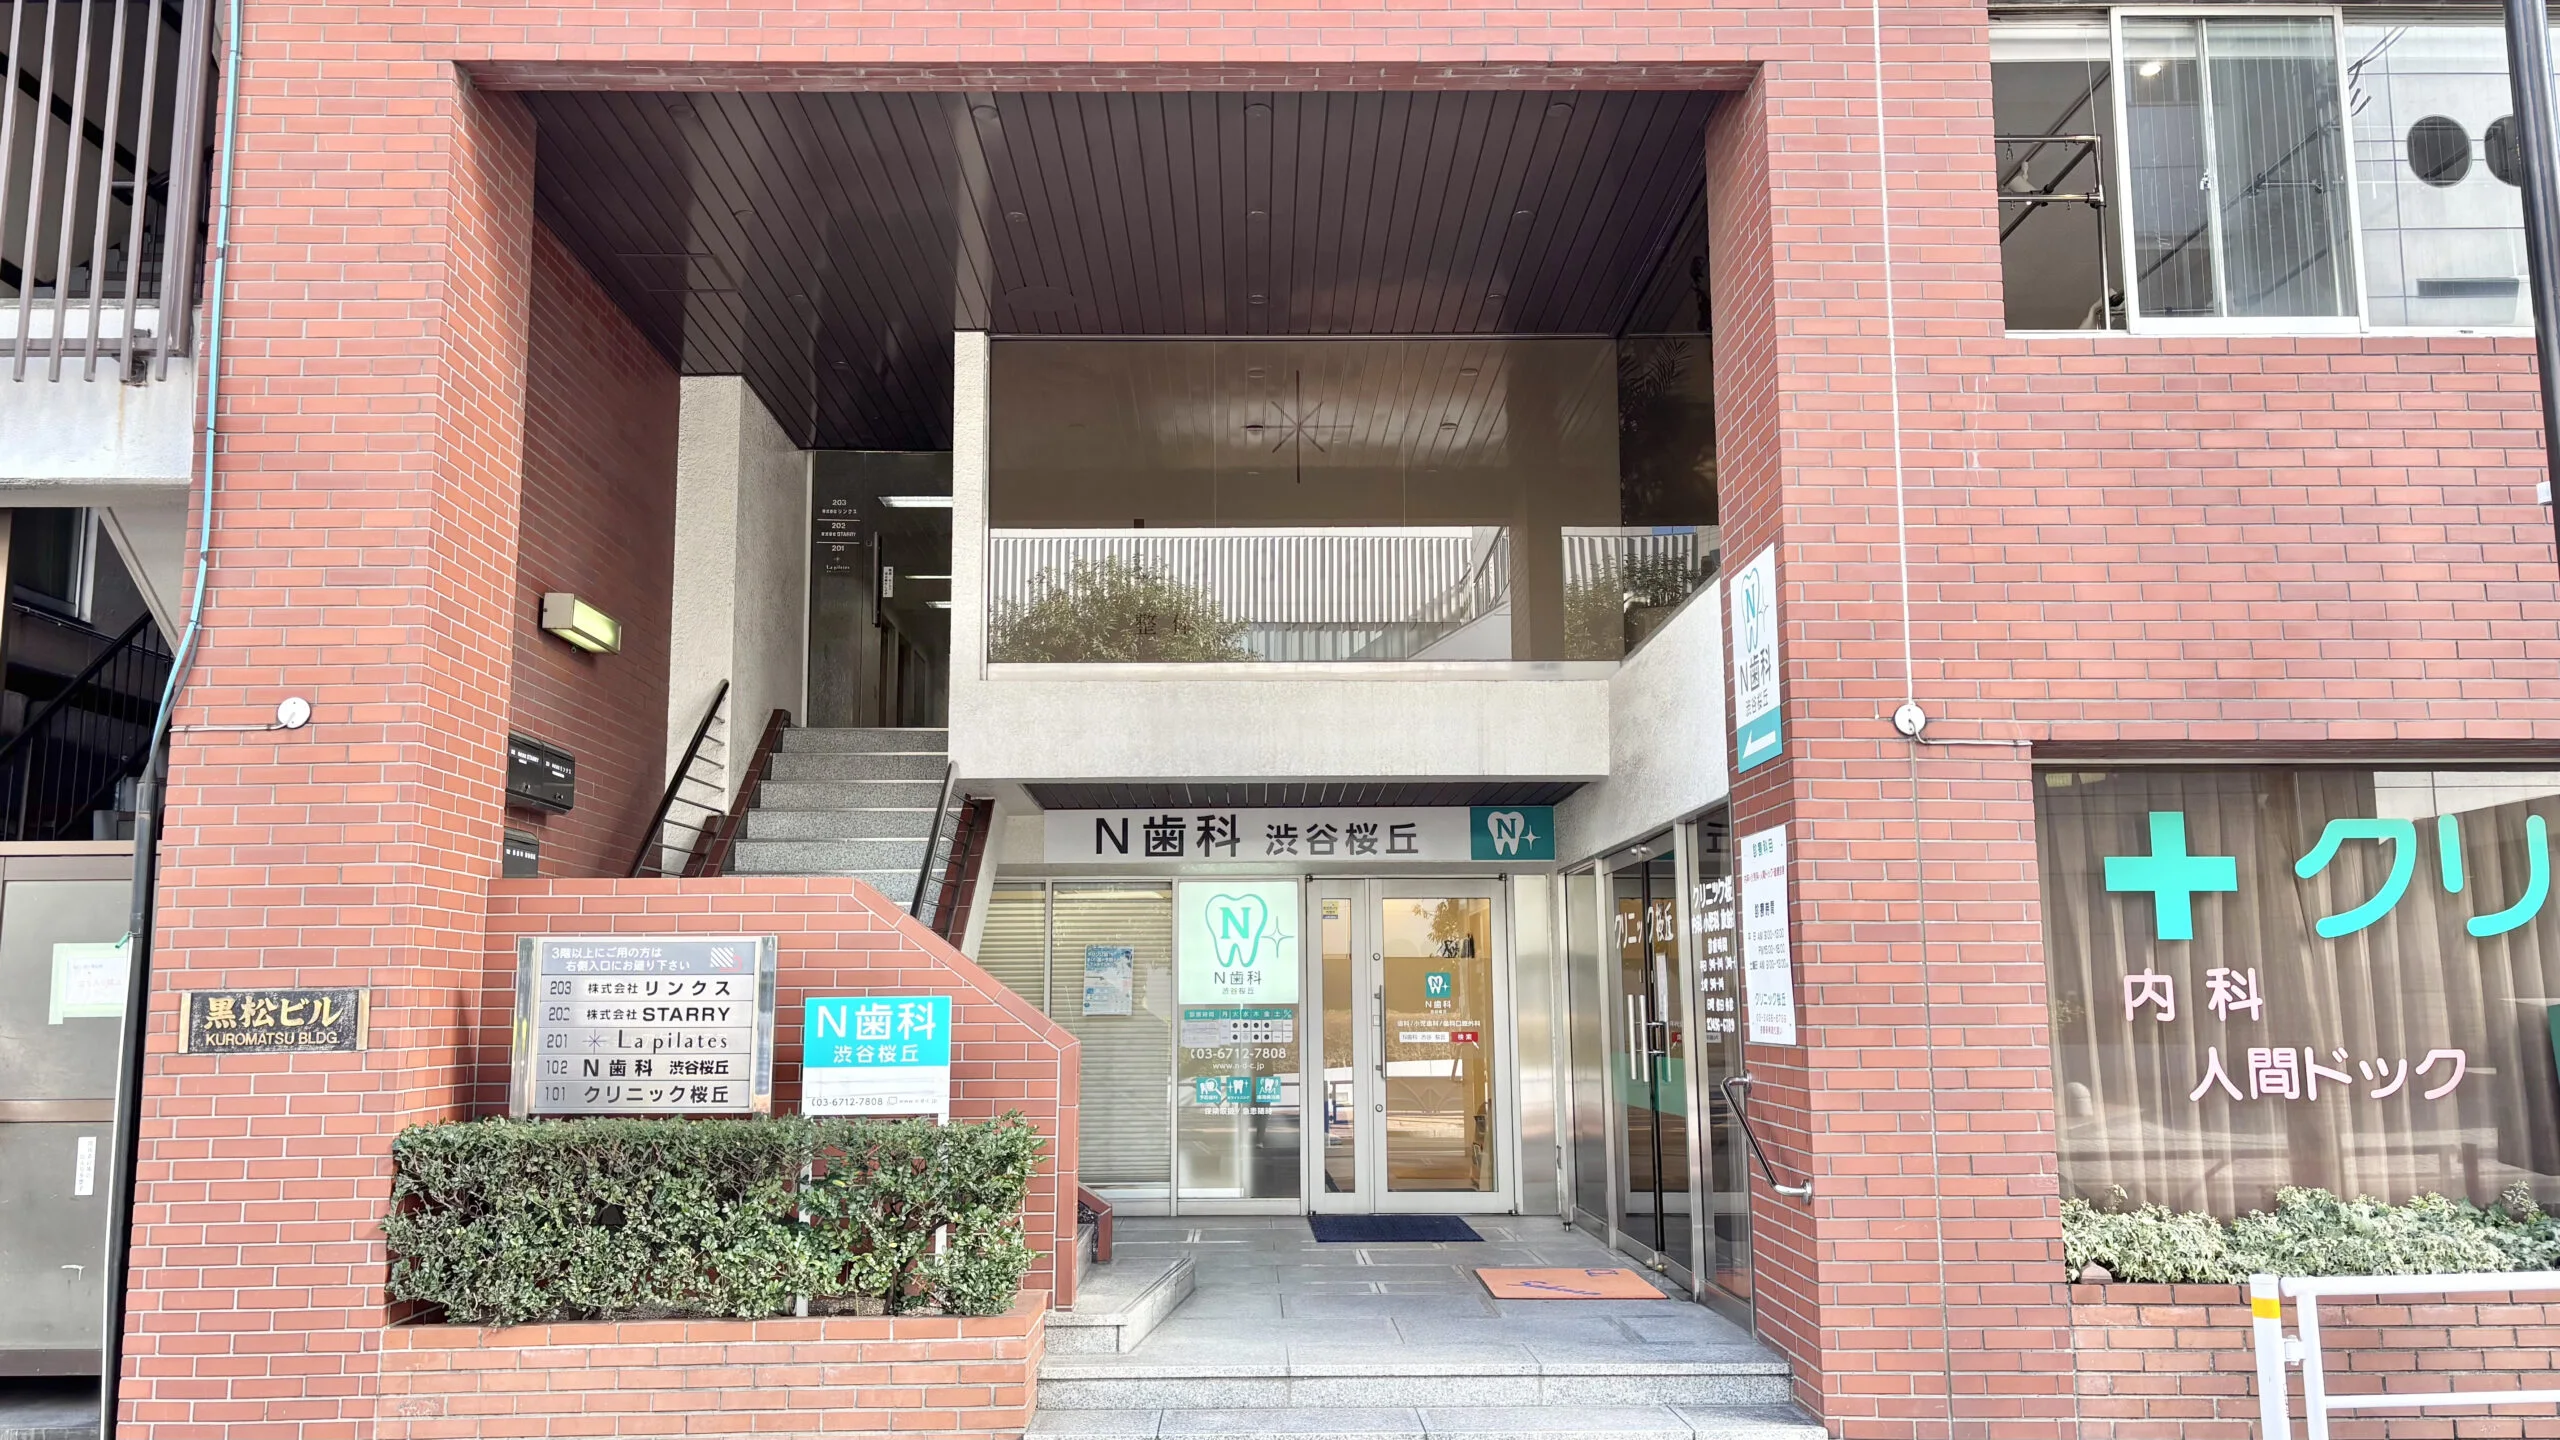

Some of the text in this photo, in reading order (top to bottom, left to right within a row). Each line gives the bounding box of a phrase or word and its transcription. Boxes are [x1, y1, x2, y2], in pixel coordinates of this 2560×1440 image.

[1740, 644, 1771, 696] N歯科
[1095, 814, 1420, 858] N歯科 渋谷桜丘
[2295, 814, 2550, 938] クリ
[551, 946, 662, 959] 3階以上にご用の方は
[1214, 970, 1262, 985] N歯科
[550, 981, 572, 995] 203
[2123, 967, 2263, 1022] 内科
[203, 995, 344, 1030] 黒松ビル
[642, 1007, 731, 1022] STARRY
[817, 1001, 936, 1040] N歯科
[205, 1031, 340, 1046] KUROMATSU BLDG.
[547, 1034, 568, 1048] 201
[833, 1044, 919, 1063] 渋谷桜丘
[1196, 1048, 1286, 1059] 03-6712-7808
[546, 1059, 568, 1074] 102
[669, 1059, 729, 1075] 渋谷桜丘
[2189, 1046, 2467, 1101] 人間ドック
[545, 1085, 729, 1104] 101 クリニック桜丘
[816, 1097, 883, 1107] 03-6712-7808
